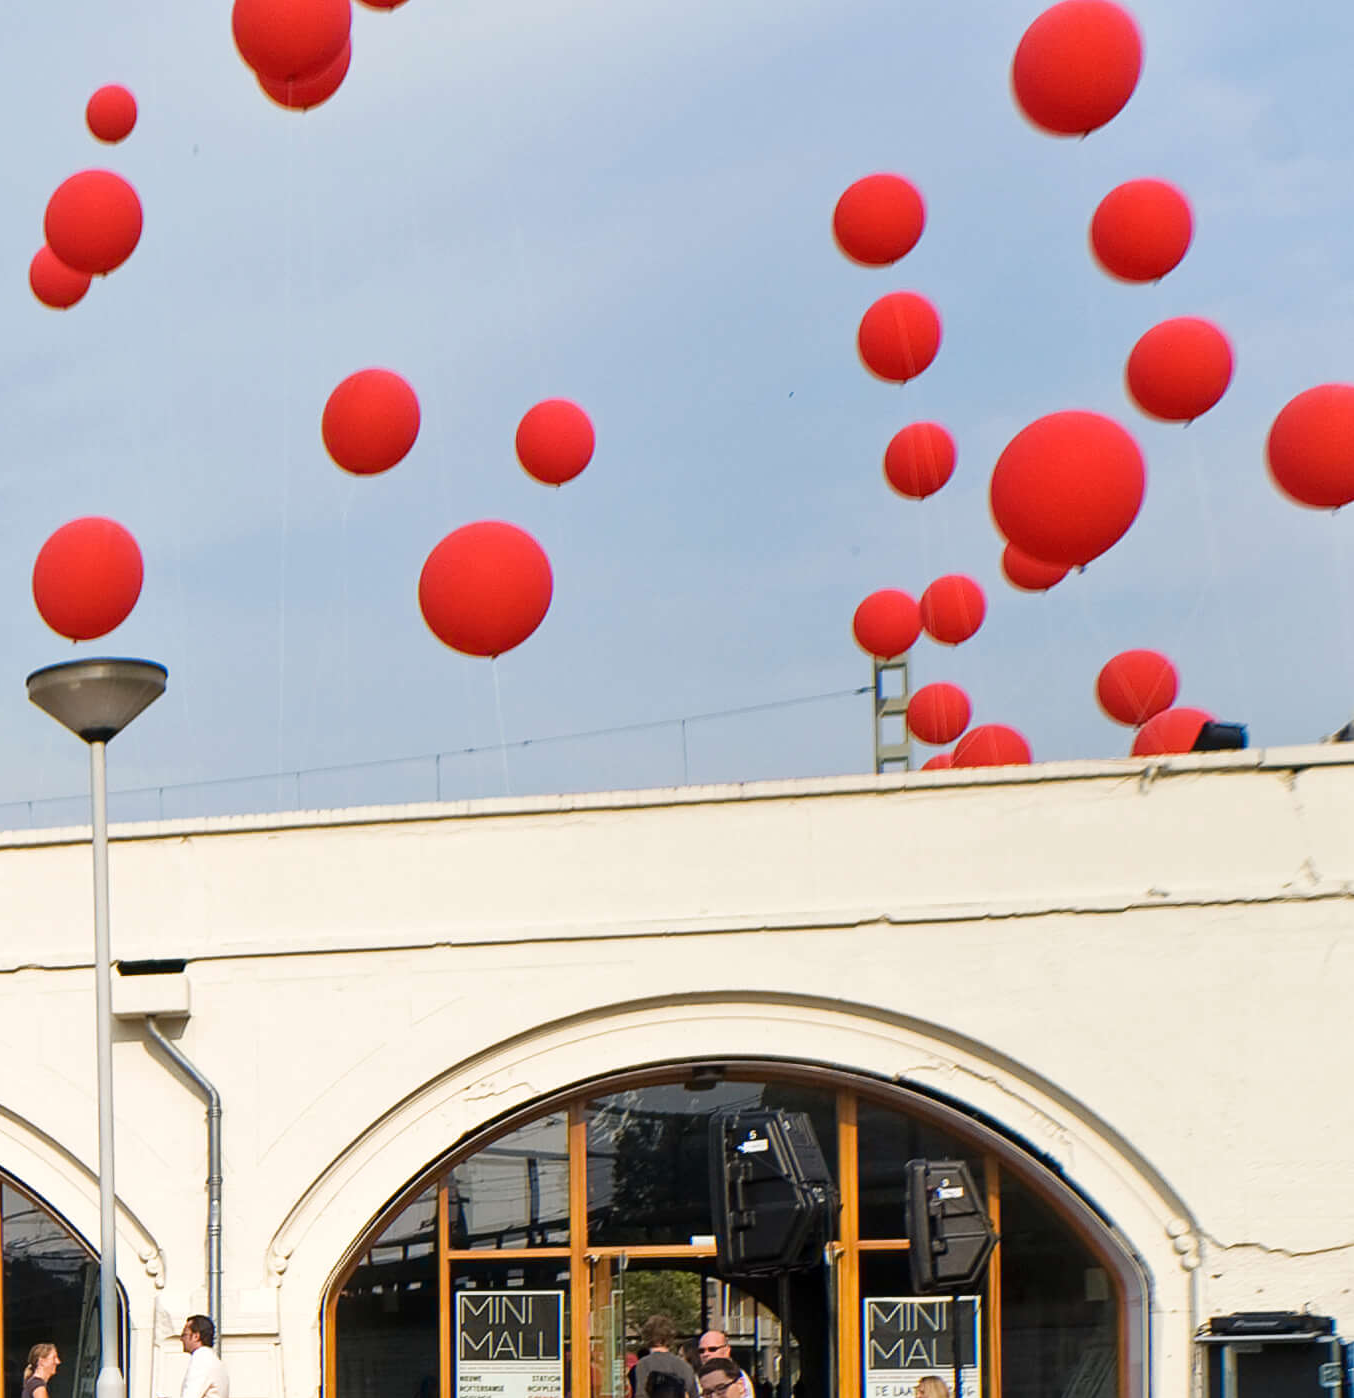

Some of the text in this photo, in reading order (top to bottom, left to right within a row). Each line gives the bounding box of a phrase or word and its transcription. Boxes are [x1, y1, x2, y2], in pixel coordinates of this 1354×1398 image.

[460, 1296, 533, 1325] MINI
[870, 1302, 947, 1332] MINI
[460, 1330, 559, 1360] MALL
[531, 1375, 561, 1383] STATION
